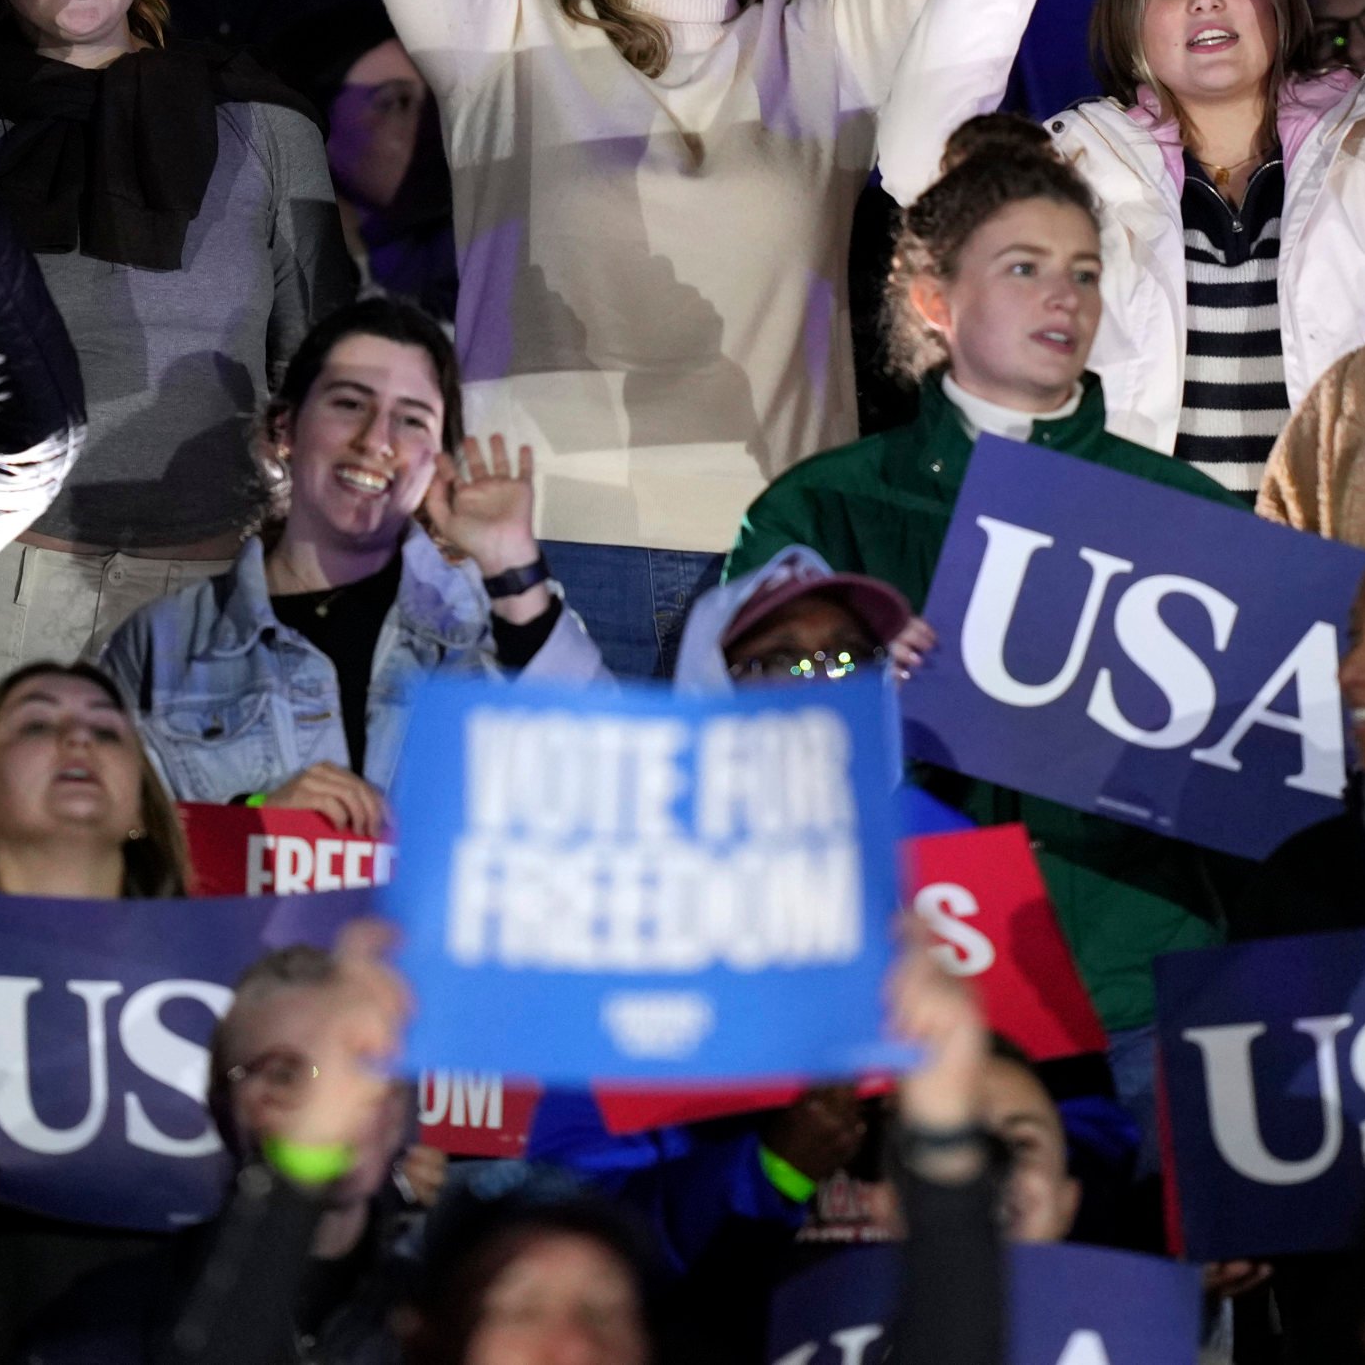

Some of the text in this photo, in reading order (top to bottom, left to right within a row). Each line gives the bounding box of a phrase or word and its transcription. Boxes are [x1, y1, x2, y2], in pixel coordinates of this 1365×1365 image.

[961, 514, 1347, 798] USA
[465, 707, 855, 840] VOTE FOR
[445, 838, 867, 973] FREEDOM
